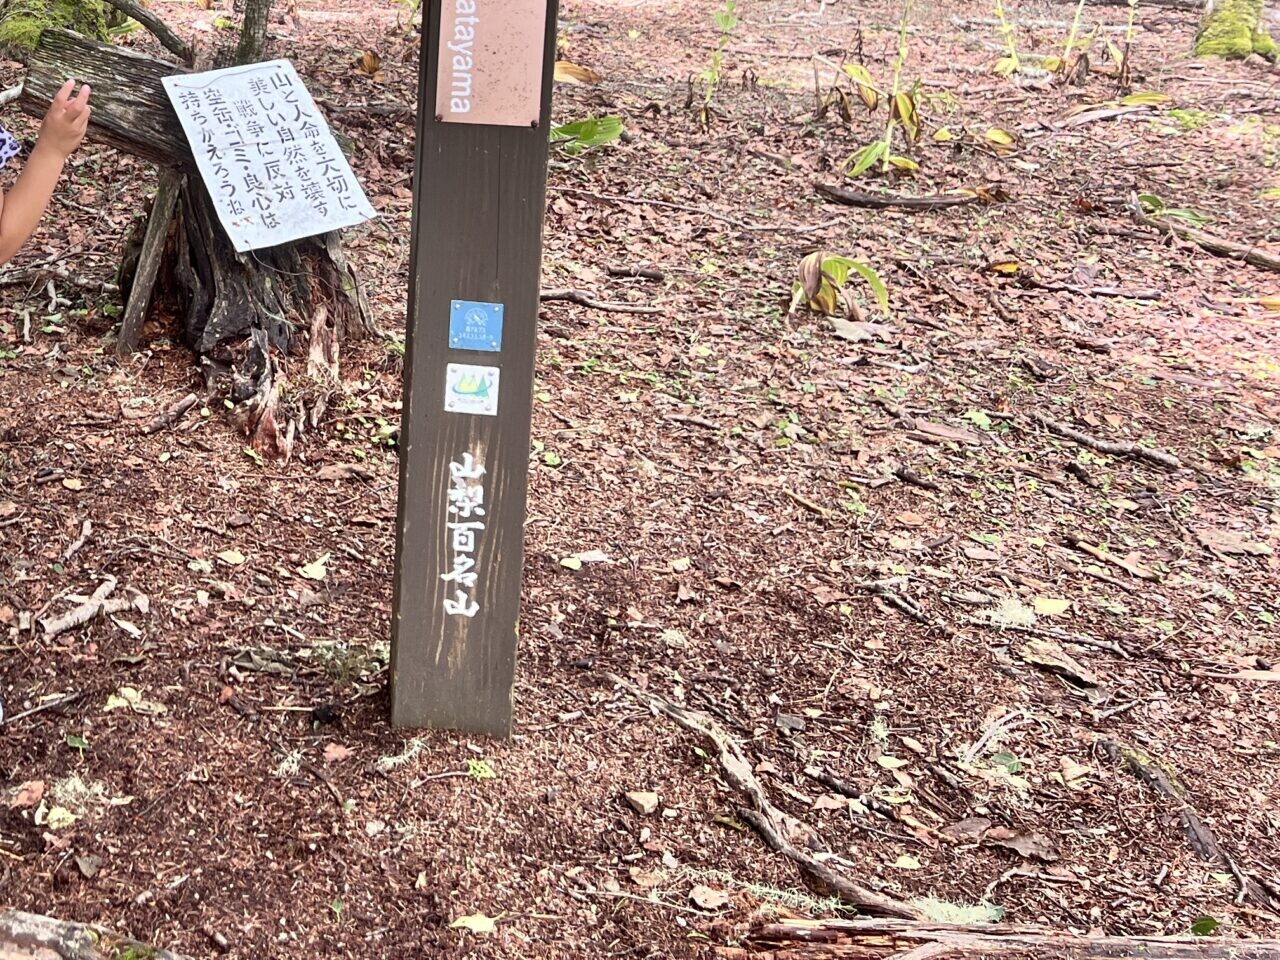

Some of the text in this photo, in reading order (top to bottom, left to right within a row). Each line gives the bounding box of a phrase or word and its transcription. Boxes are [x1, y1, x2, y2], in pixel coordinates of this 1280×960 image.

[233, 98, 296, 202] 戦争に反対
[249, 76, 328, 217] 美しい自然を壊す
[271, 72, 357, 211] 山と人命を大切に
[440, 452, 487, 617] 山梨百名山
